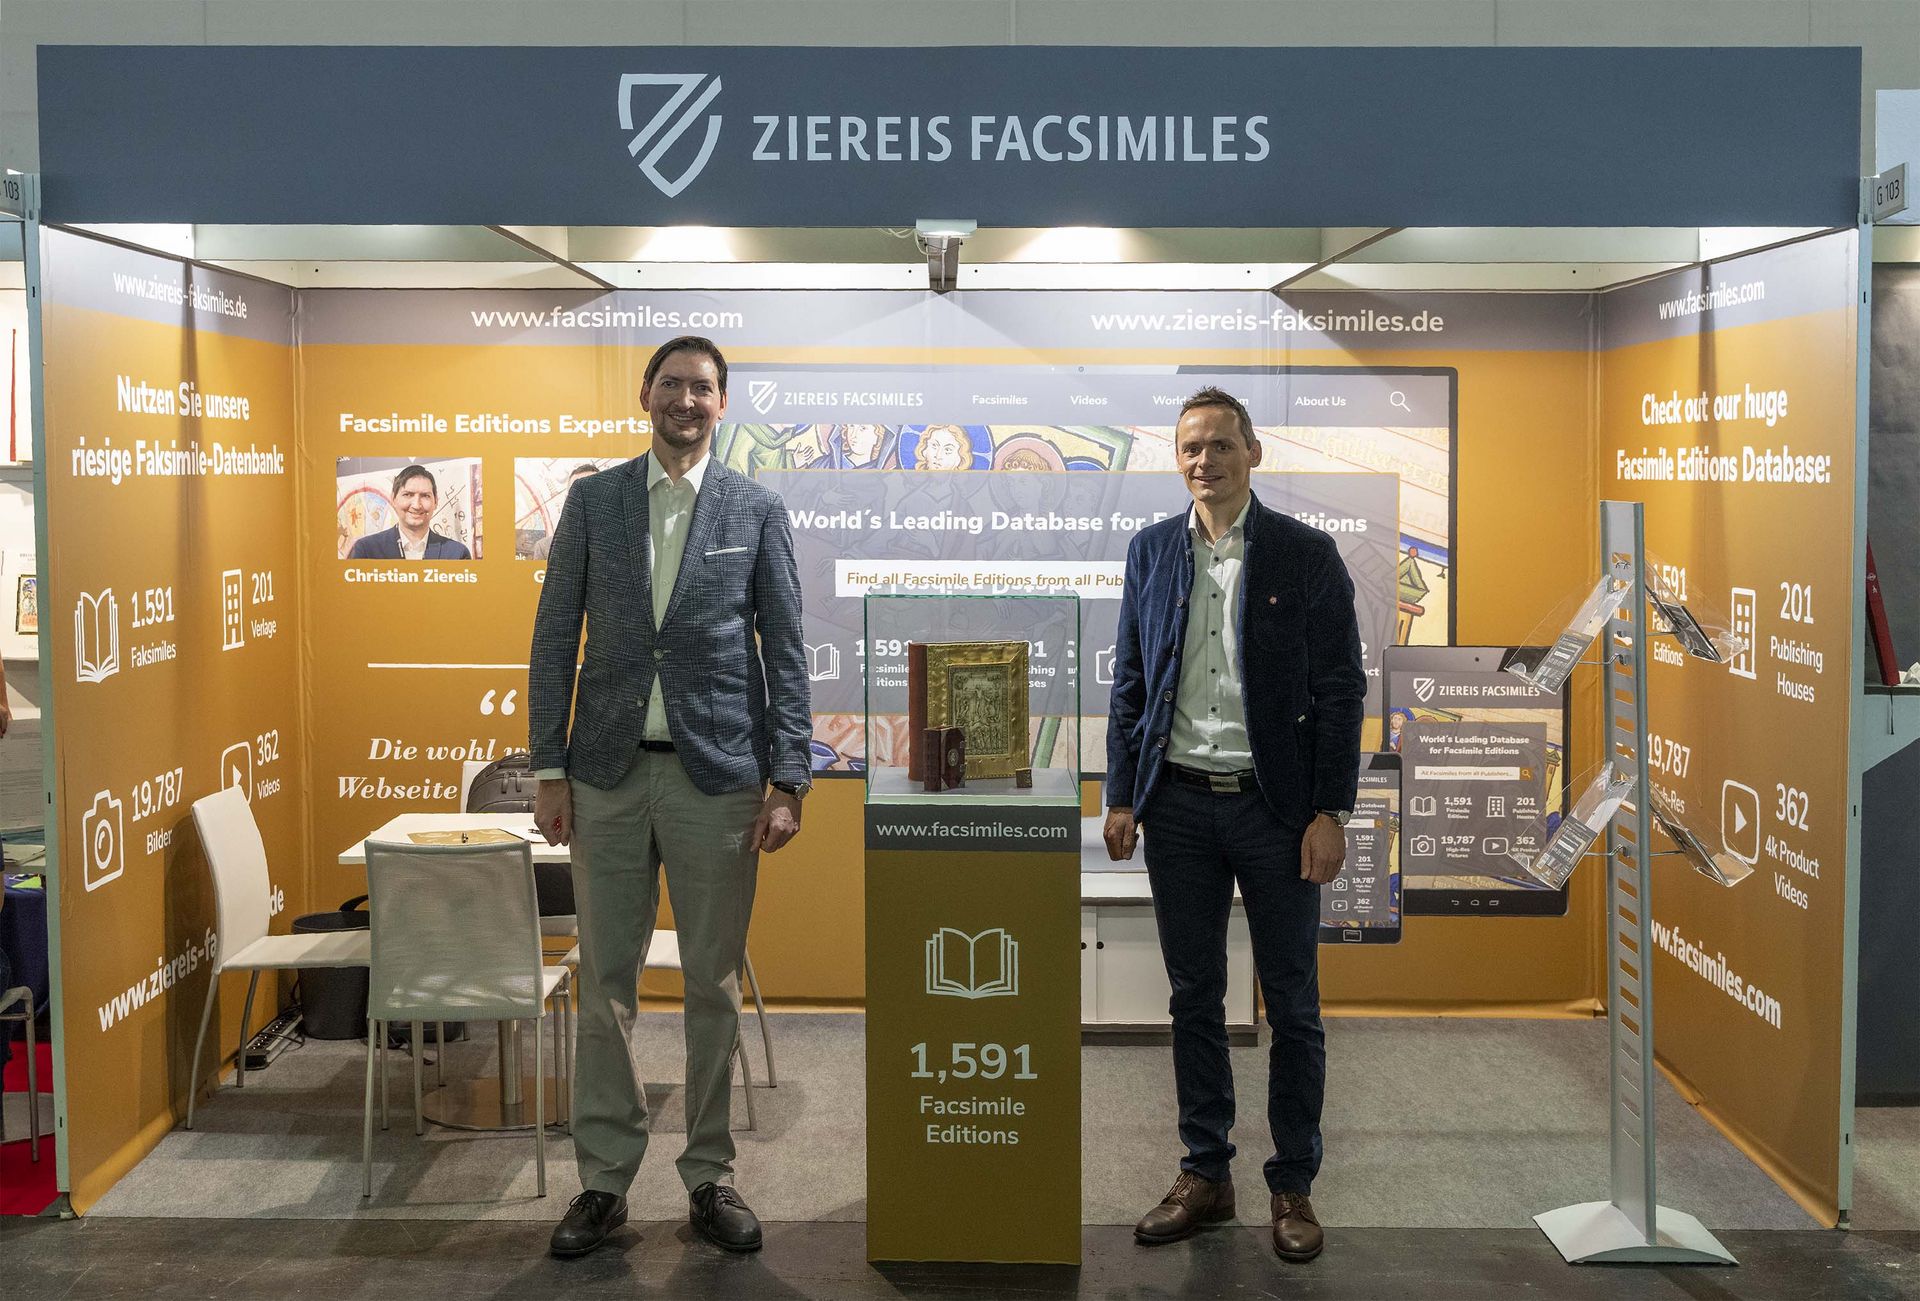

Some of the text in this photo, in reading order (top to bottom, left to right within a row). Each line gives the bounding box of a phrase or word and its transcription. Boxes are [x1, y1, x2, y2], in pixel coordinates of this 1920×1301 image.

[752, 115, 1270, 163] ZIEREIS FACSIMILES
[3, 179, 20, 201] 103
[1876, 179, 1900, 206] G 103
[113, 271, 247, 320] www.ziereis-faksimiles.de
[1659, 280, 1765, 320] www.facsimiles.com
[471, 306, 743, 330] www.facsimiles.com
[1091, 309, 1444, 333] www.ziereis-faksimiles.de
[117, 375, 250, 420] Nutzen Sie unsere
[784, 391, 923, 407] ZIEREIS FACSIMILES
[972, 394, 1028, 406] Facsimiles
[1070, 395, 1108, 406] Videos
[1295, 395, 1346, 407] About Us
[1641, 383, 1788, 427] Check out our huge
[340, 413, 447, 433] Facsimile
[455, 413, 551, 434] Editions
[72, 437, 284, 485] riesige Faksimile-Datenbank:
[1617, 445, 1831, 484] Facsimile Editions Database:
[889, 511, 983, 535] Leading
[991, 511, 1103, 532] Database
[1110, 512, 1146, 532] for
[1294, 512, 1368, 533] itions
[252, 570, 274, 605] 201
[344, 568, 478, 584] Christian Ziereis
[847, 572, 879, 585] Find
[882, 572, 899, 586] all
[903, 573, 969, 586] Facsimile
[973, 573, 1031, 586] Editions
[1036, 573, 1072, 586] from
[1075, 574, 1091, 586] all
[131, 586, 175, 629] 1.591
[1779, 581, 1815, 625] 201
[251, 618, 277, 640] Verlage
[130, 642, 177, 669] Faksimiles
[1653, 641, 1684, 667] Editions
[1770, 635, 1823, 674] Publishing
[860, 663, 910, 673] Fsimile
[863, 677, 907, 687] itions
[1439, 685, 1540, 698] ZIEREIS FACSIMILES
[1776, 672, 1815, 703] Houses
[257, 729, 279, 766] 362
[368, 738, 418, 760] Die
[426, 738, 495, 761] wohl
[1429, 747, 1520, 755] for Facsimile Editions
[1455, 736, 1488, 745] Leading
[1490, 736, 1530, 744] Database
[1648, 733, 1690, 779] 19,787
[132, 767, 184, 822] 19.787
[257, 778, 281, 800] Videos
[337, 776, 458, 800] Webseite
[1444, 796, 1473, 806] 1,591
[1516, 797, 1536, 806] 201
[1775, 783, 1809, 832] 362
[146, 827, 173, 856] Bilder
[876, 821, 1068, 839] www.facsimiles.com
[1440, 836, 1476, 846] 19,787
[1515, 837, 1536, 845] 362
[1765, 834, 1819, 880] 4k Product
[1774, 872, 1808, 910] Videos
[1651, 920, 1781, 1030] ww.facsimiles.com
[910, 1042, 1038, 1085] 1,591
[920, 1095, 1026, 1116] Facsimile
[926, 1124, 1020, 1146] Editions
